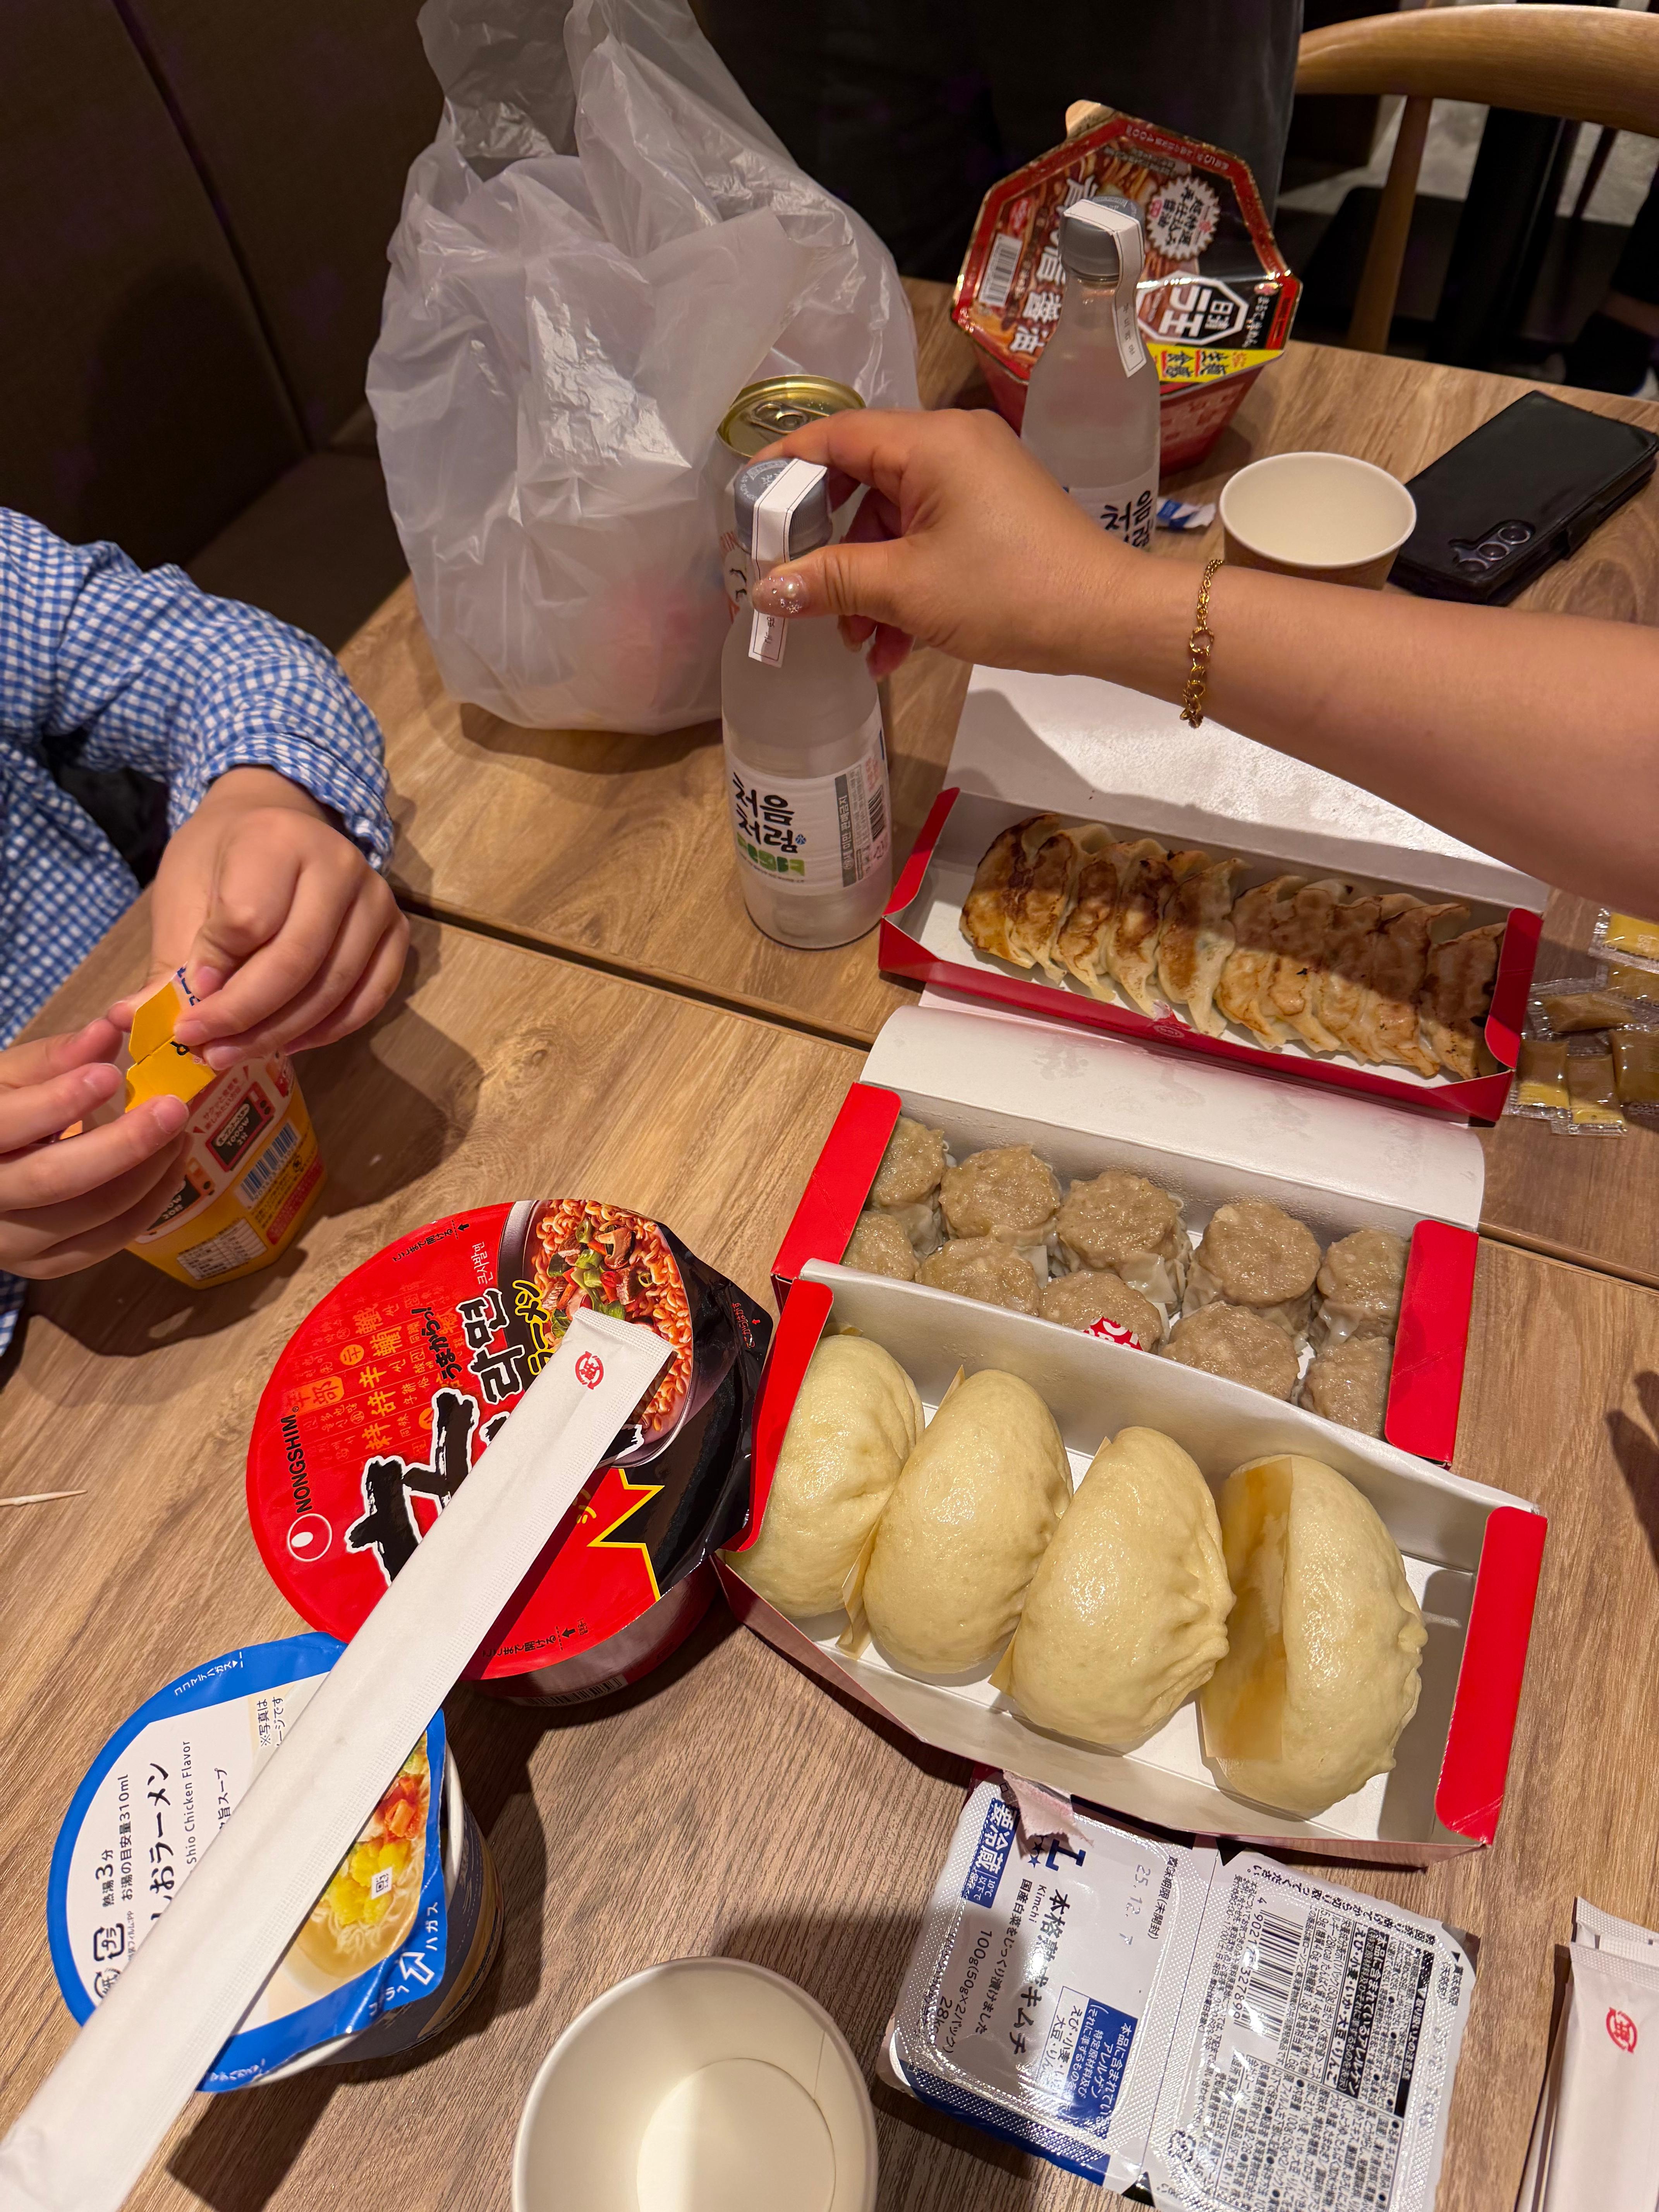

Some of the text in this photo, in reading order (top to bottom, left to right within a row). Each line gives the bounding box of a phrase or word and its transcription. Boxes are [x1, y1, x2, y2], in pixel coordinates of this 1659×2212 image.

[1206, 299, 1233, 333] 日清
[732, 771, 795, 826] 처음
[736, 803, 798, 854] 처럼
[226, 1117, 250, 1146] 1000W
[392, 1228, 453, 1262] ここまで開ける
[472, 1242, 489, 1286] 큰사발면
[410, 1307, 465, 1387] うまからっ!
[457, 1288, 526, 1404] 라면
[282, 1414, 312, 1513] NONGSHIM
[482, 1635, 556, 1657] ここまで開ける
[174, 1659, 233, 1696] ココマデハガス
[257, 1699, 271, 1746] ※写真は
[181, 1741, 197, 1863] Shio Chicken Flavor
[215, 1768, 231, 1829] 旨スープ
[118, 1774, 132, 1900] お湯の目安量310ml
[974, 1802, 1016, 1874] 要冷蔵
[1044, 1838, 1087, 1872] L
[95, 1849, 114, 1907] 熱湯3分
[974, 1875, 988, 1901] 以下で
[1027, 1884, 1048, 1923] Kimchi
[1146, 1855, 1178, 1940] 賞味期限(未開封)
[101, 1927, 118, 1951] プラ
[425, 1901, 438, 1952] ハガス
[974, 1878, 1032, 2036] 国産白菜をじっくり漬けました
[941, 1927, 993, 2054] 100g(50g×2パック)
[1326, 1927, 1366, 2084] えび・小麦・いか・大豆・りんご
[1348, 1934, 1387, 2094] 本品に含まれているアレルゲン
[1089, 2041, 1113, 2099] アレルゲン
